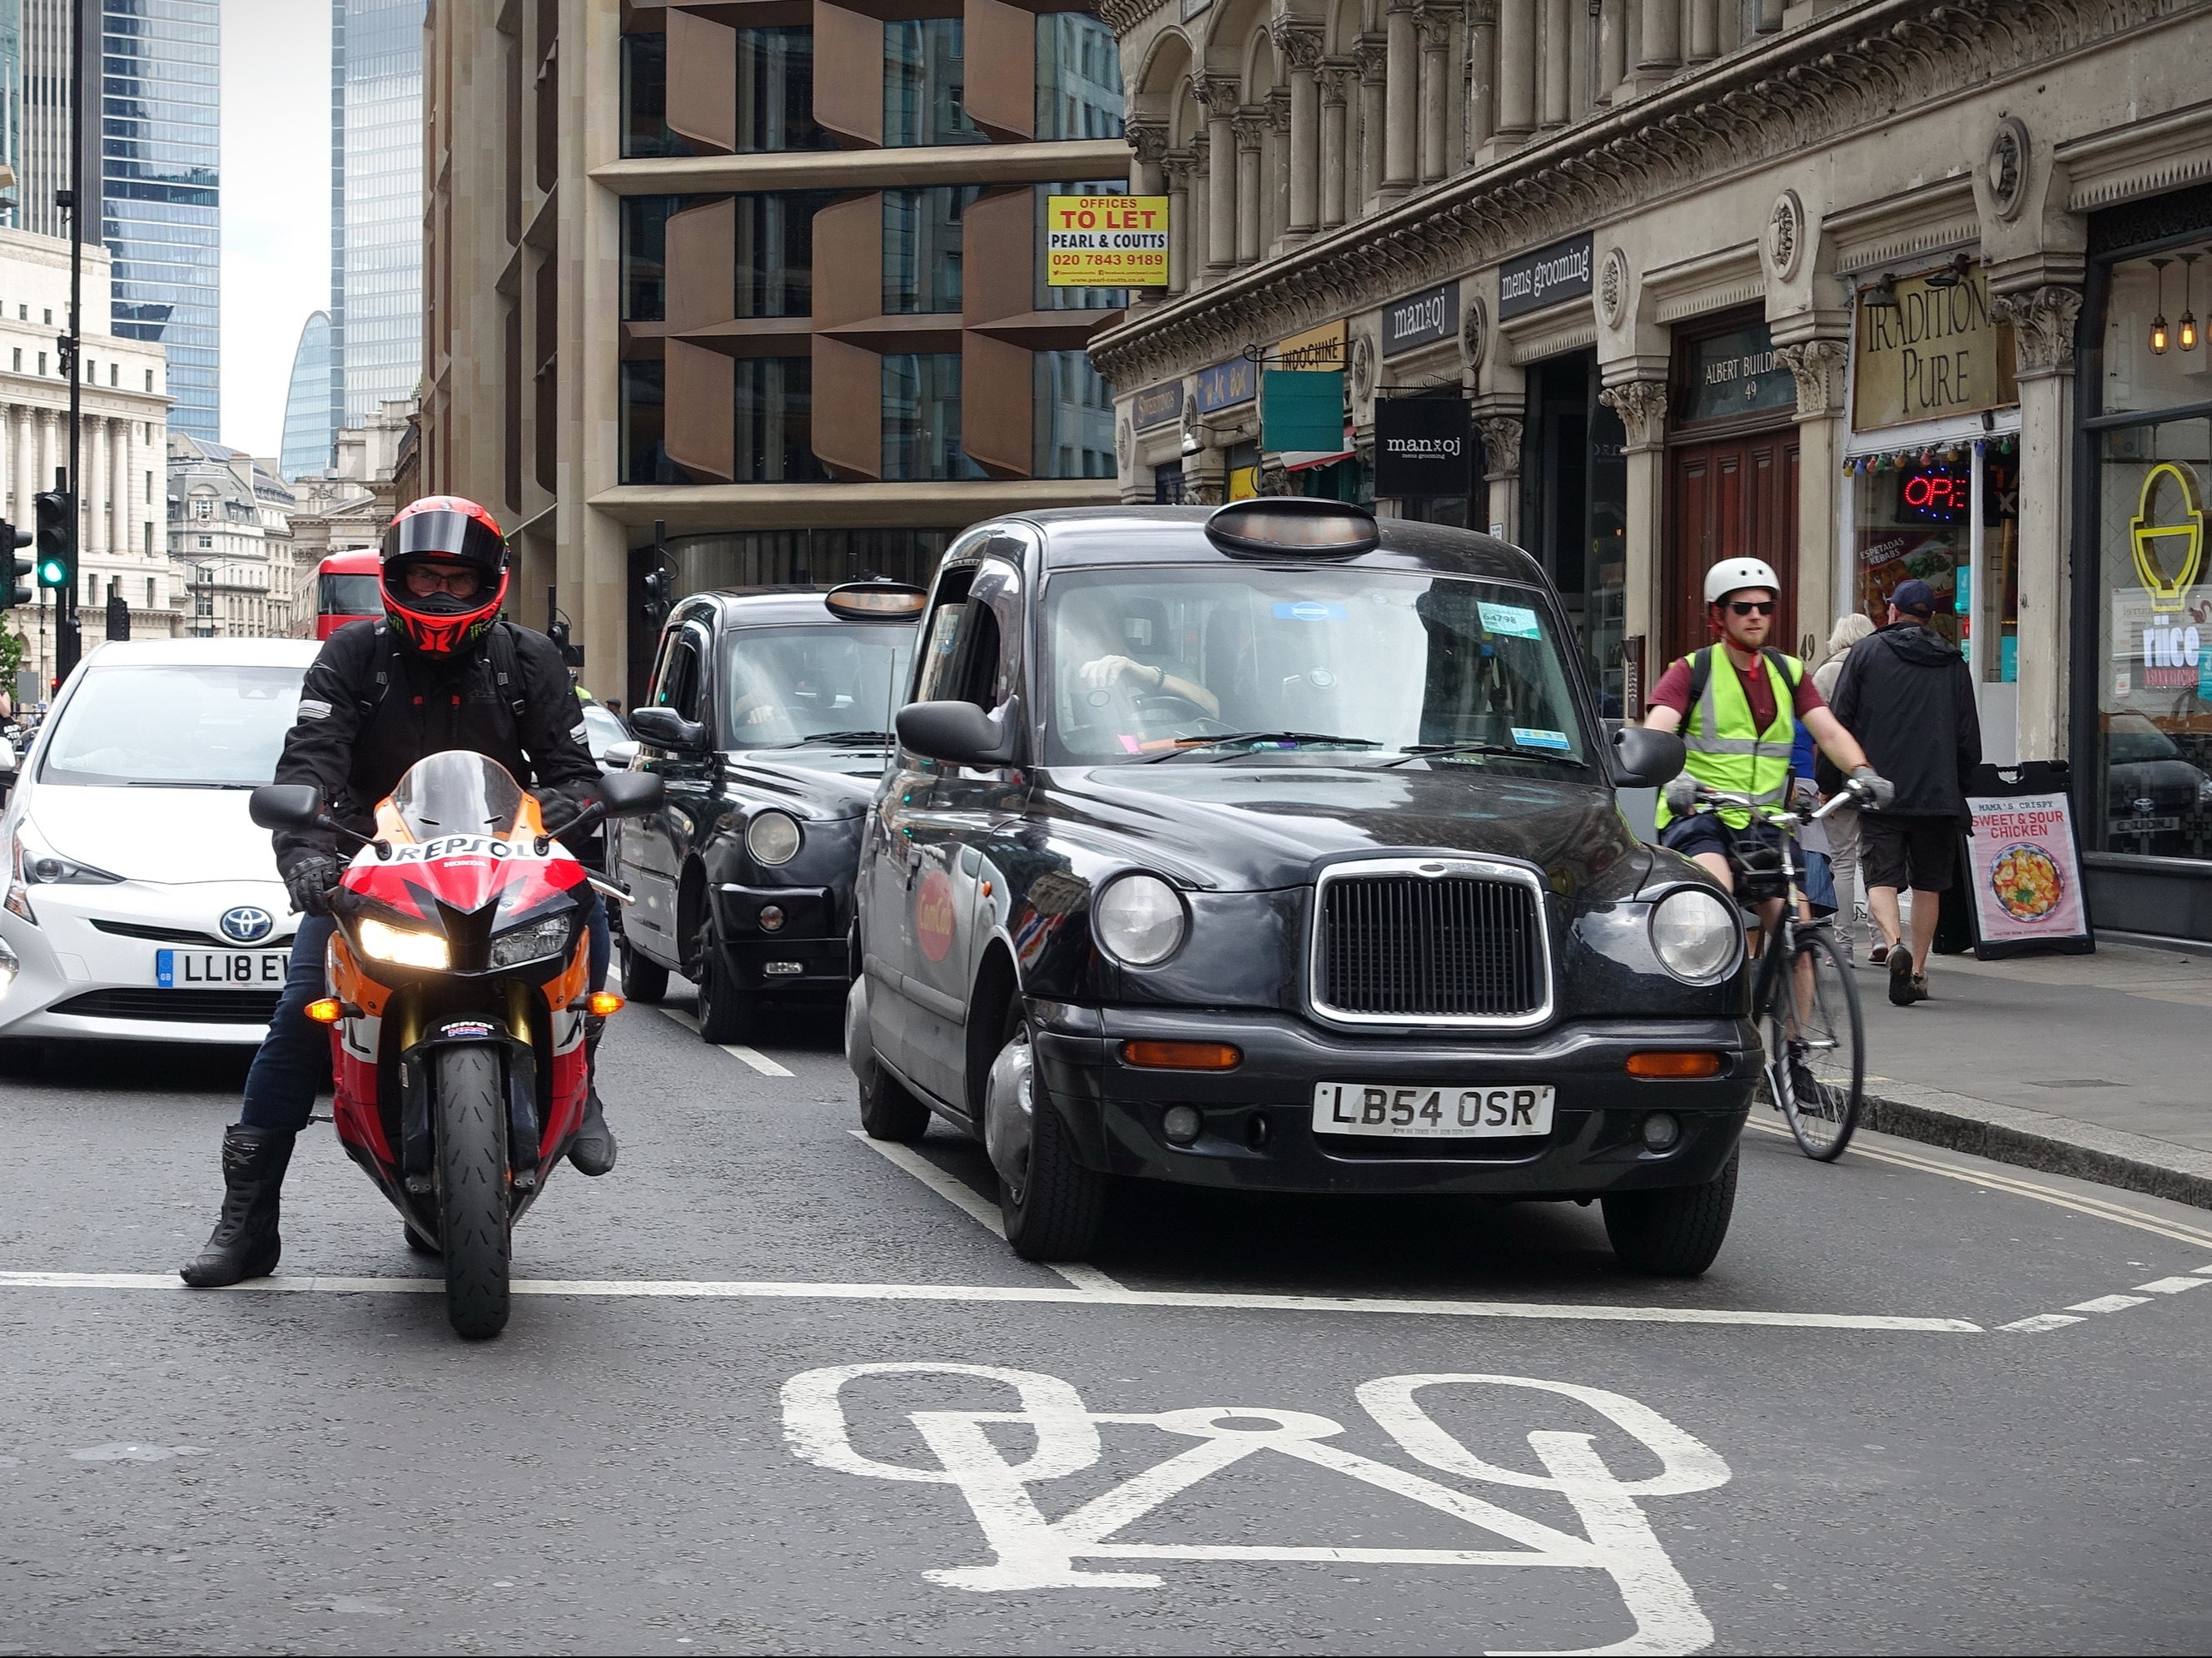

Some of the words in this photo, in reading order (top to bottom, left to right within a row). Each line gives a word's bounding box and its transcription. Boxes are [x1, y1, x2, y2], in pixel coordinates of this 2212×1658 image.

[1080, 199, 1137, 208] OFFICES
[1060, 211, 1096, 229] TO
[1106, 211, 1156, 229] LET
[1051, 234, 1095, 248] PEARL
[1099, 234, 1110, 248] &
[1113, 234, 1165, 248] COUTTS
[1053, 254, 1080, 266] 020
[1085, 254, 1121, 266] 7843
[1126, 254, 1163, 266] 9189
[1502, 269, 1531, 300] mens
[1533, 246, 1589, 297] grooming
[1868, 276, 1991, 353] TRADITION
[1282, 336, 1338, 371] INDOCHINE
[1705, 360, 1739, 385] ALBERT
[1902, 348, 1970, 414] PURE
[1744, 380, 1757, 400] 49
[1905, 477, 1966, 506] OPE
[1859, 538, 1905, 560] ESPETADAS
[1869, 548, 1901, 566] KEBABS
[1484, 613, 1516, 624] 64798
[1800, 633, 1815, 662] 49
[1979, 803, 2014, 812] MAMA'S
[2020, 801, 2053, 809] CRISPY
[1972, 814, 2015, 827] SWEET
[2018, 812, 2026, 824] &
[2029, 811, 2064, 824] SOUR
[1991, 825, 2048, 839] CHICKEN
[395, 837, 530, 861] REPSOL
[444, 860, 488, 868] HONDA
[185, 955, 251, 981] LL18
[440, 1021, 495, 1032] REPSOL
[1332, 1086, 1443, 1126] LB54
[1457, 1090, 1536, 1126] OSR
